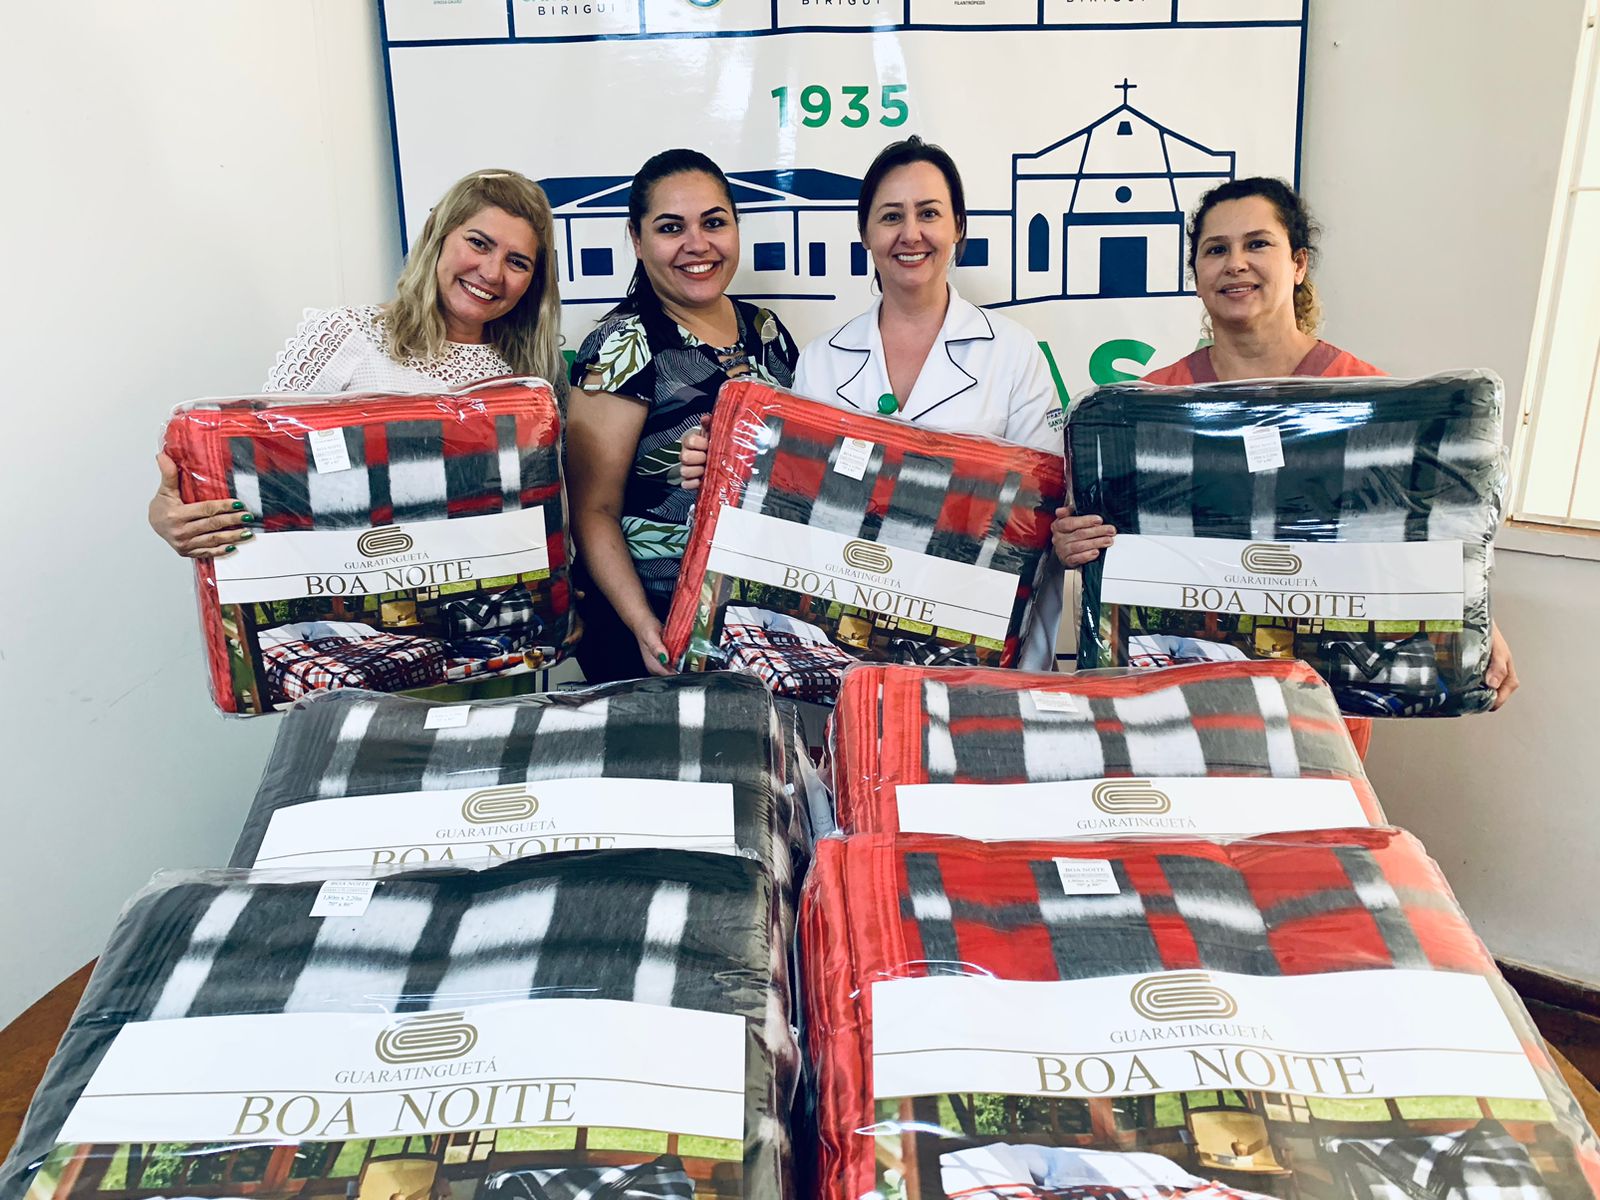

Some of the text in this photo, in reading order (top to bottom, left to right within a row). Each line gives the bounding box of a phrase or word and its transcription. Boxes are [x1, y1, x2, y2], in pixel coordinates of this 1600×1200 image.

[538, 5, 615, 16] BIRIGUI
[771, 84, 909, 128] 1935
[344, 552, 430, 570] GUARATINGUETÁ
[305, 560, 474, 596] BOA NOITE
[825, 563, 902, 589] GUARATINGUETÁ
[1224, 575, 1319, 588] GUARATINGUETÁ
[783, 567, 937, 623] BOA NOITE
[1180, 587, 1367, 618] BOA NOITE
[435, 819, 557, 839] GUARATINGUETÁ
[1077, 817, 1197, 830] GUARATINGUETÁ
[1110, 1023, 1274, 1045] GUARATINGUETÁ
[335, 1056, 498, 1085] GUARATINGUETÁ
[1032, 1048, 1376, 1095] BOA NOITE
[227, 1082, 577, 1137] BOA NOITE
